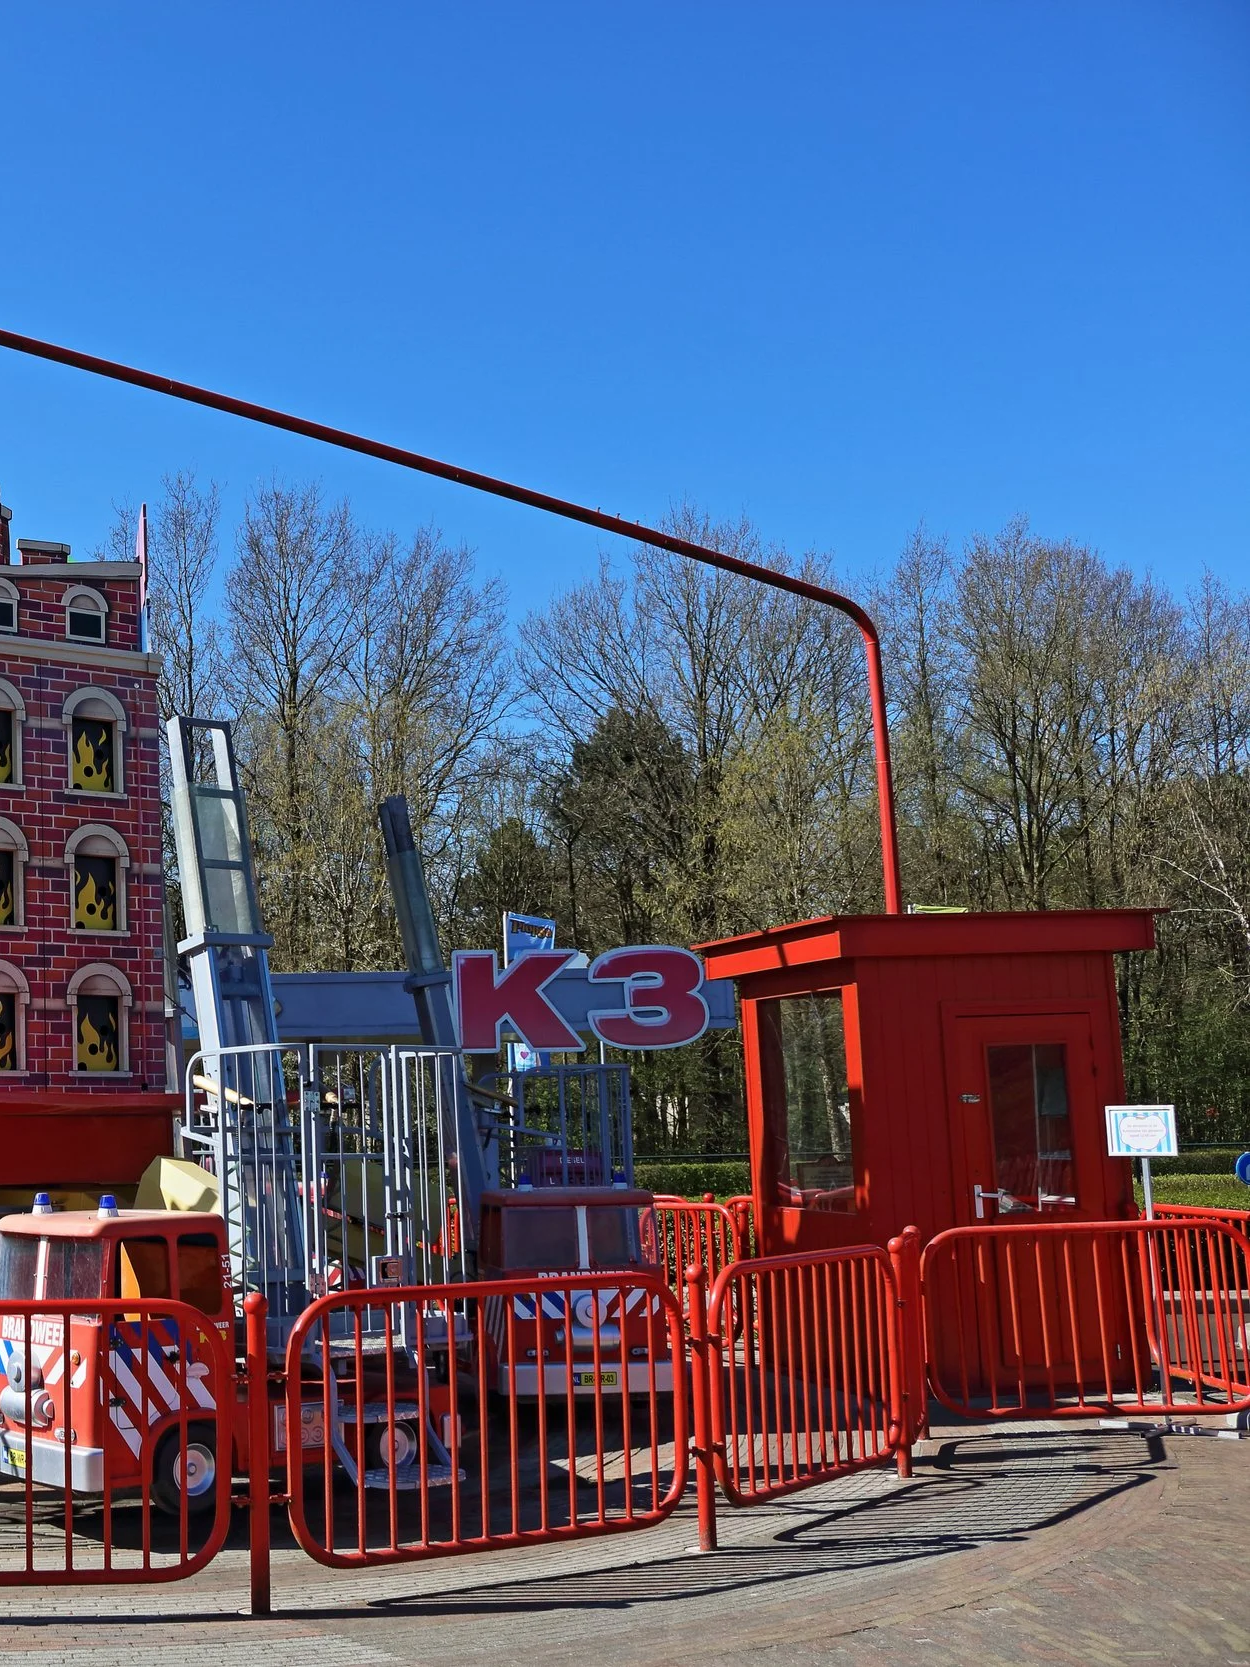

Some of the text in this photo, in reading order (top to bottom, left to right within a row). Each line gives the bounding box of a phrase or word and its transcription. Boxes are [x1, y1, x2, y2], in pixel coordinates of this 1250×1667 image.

[510, 919, 553, 939] Plopsa
[452, 945, 710, 1052] K3
[222, 1253, 233, 1290] 21-51
[584, 1374, 615, 1384] BR-R-03
